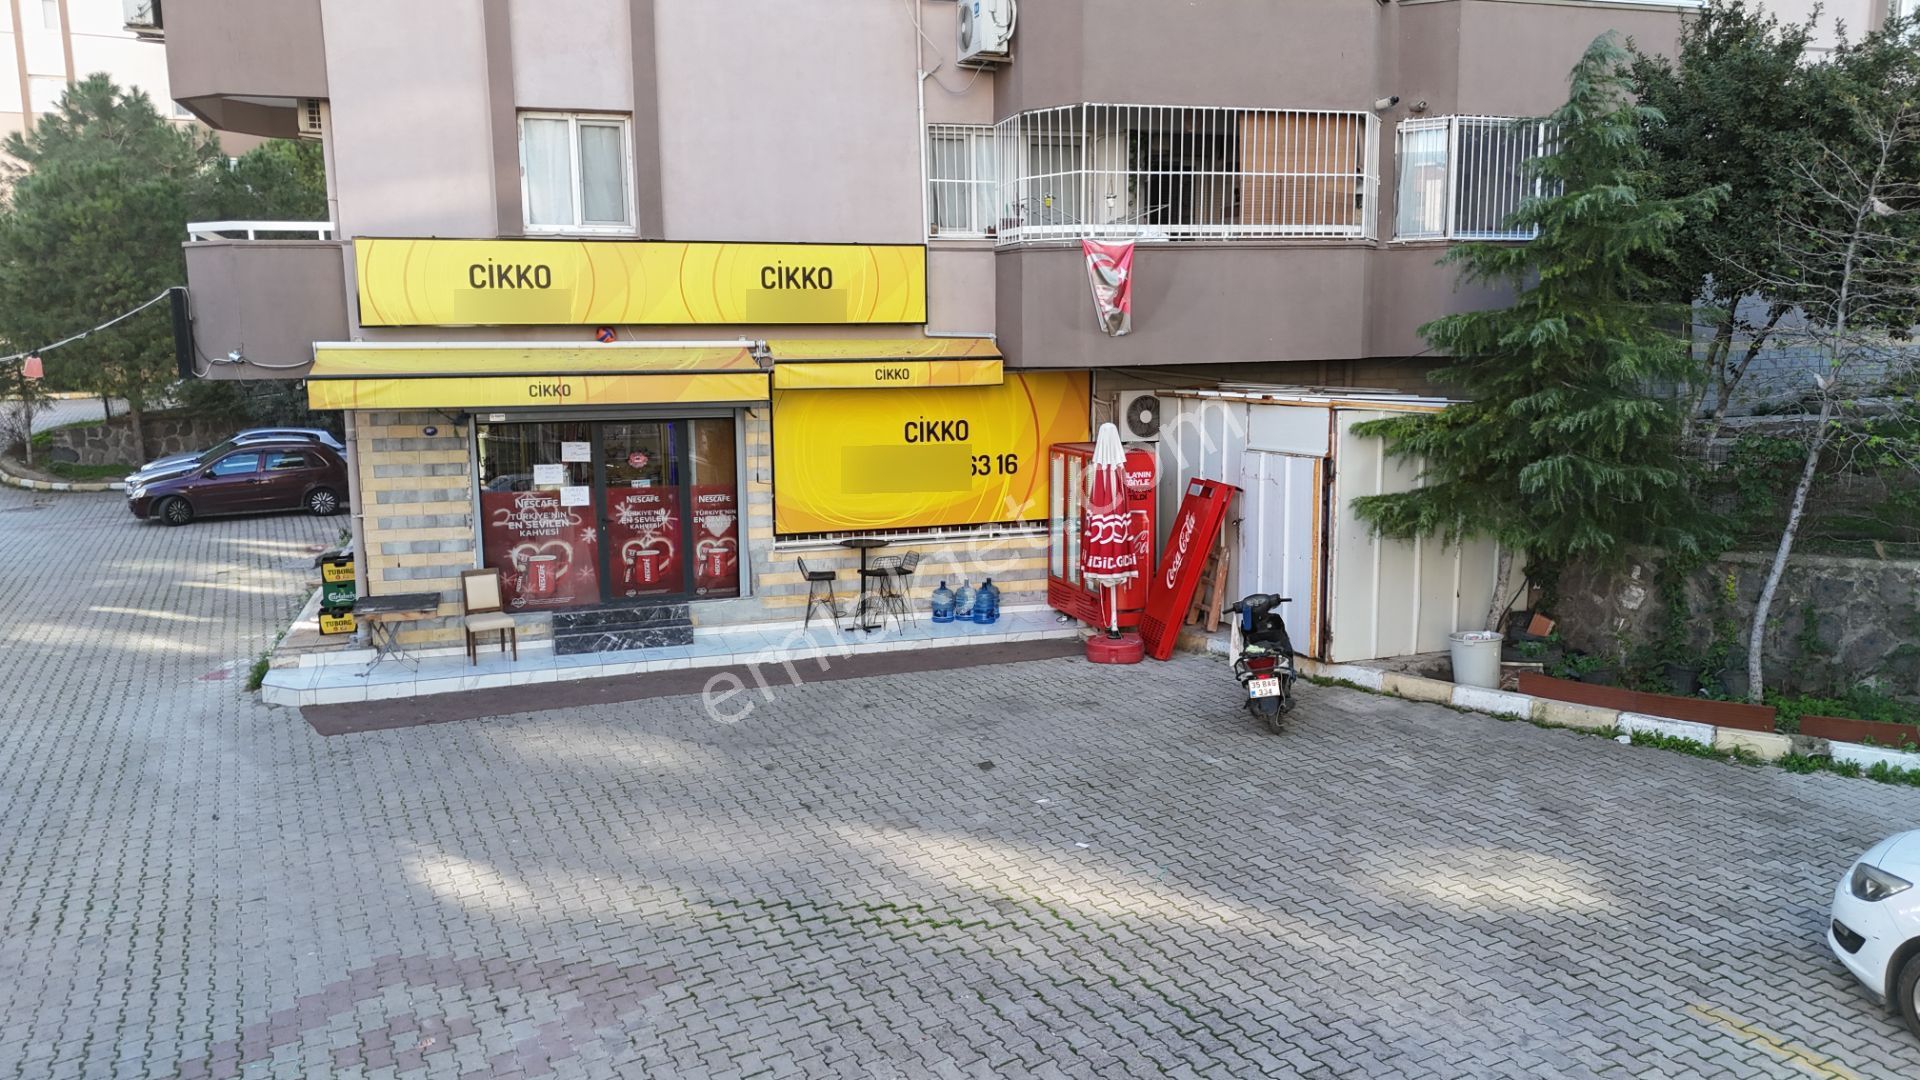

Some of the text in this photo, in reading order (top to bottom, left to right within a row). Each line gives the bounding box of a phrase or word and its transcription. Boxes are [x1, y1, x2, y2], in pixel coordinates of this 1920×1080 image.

[469, 257, 551, 289] CİKKO
[761, 260, 833, 290] CİKKO
[874, 366, 910, 381] CİKKO
[528, 382, 572, 398] CİKKO
[904, 415, 969, 443] CİKKO
[996, 453, 1018, 475] 16
